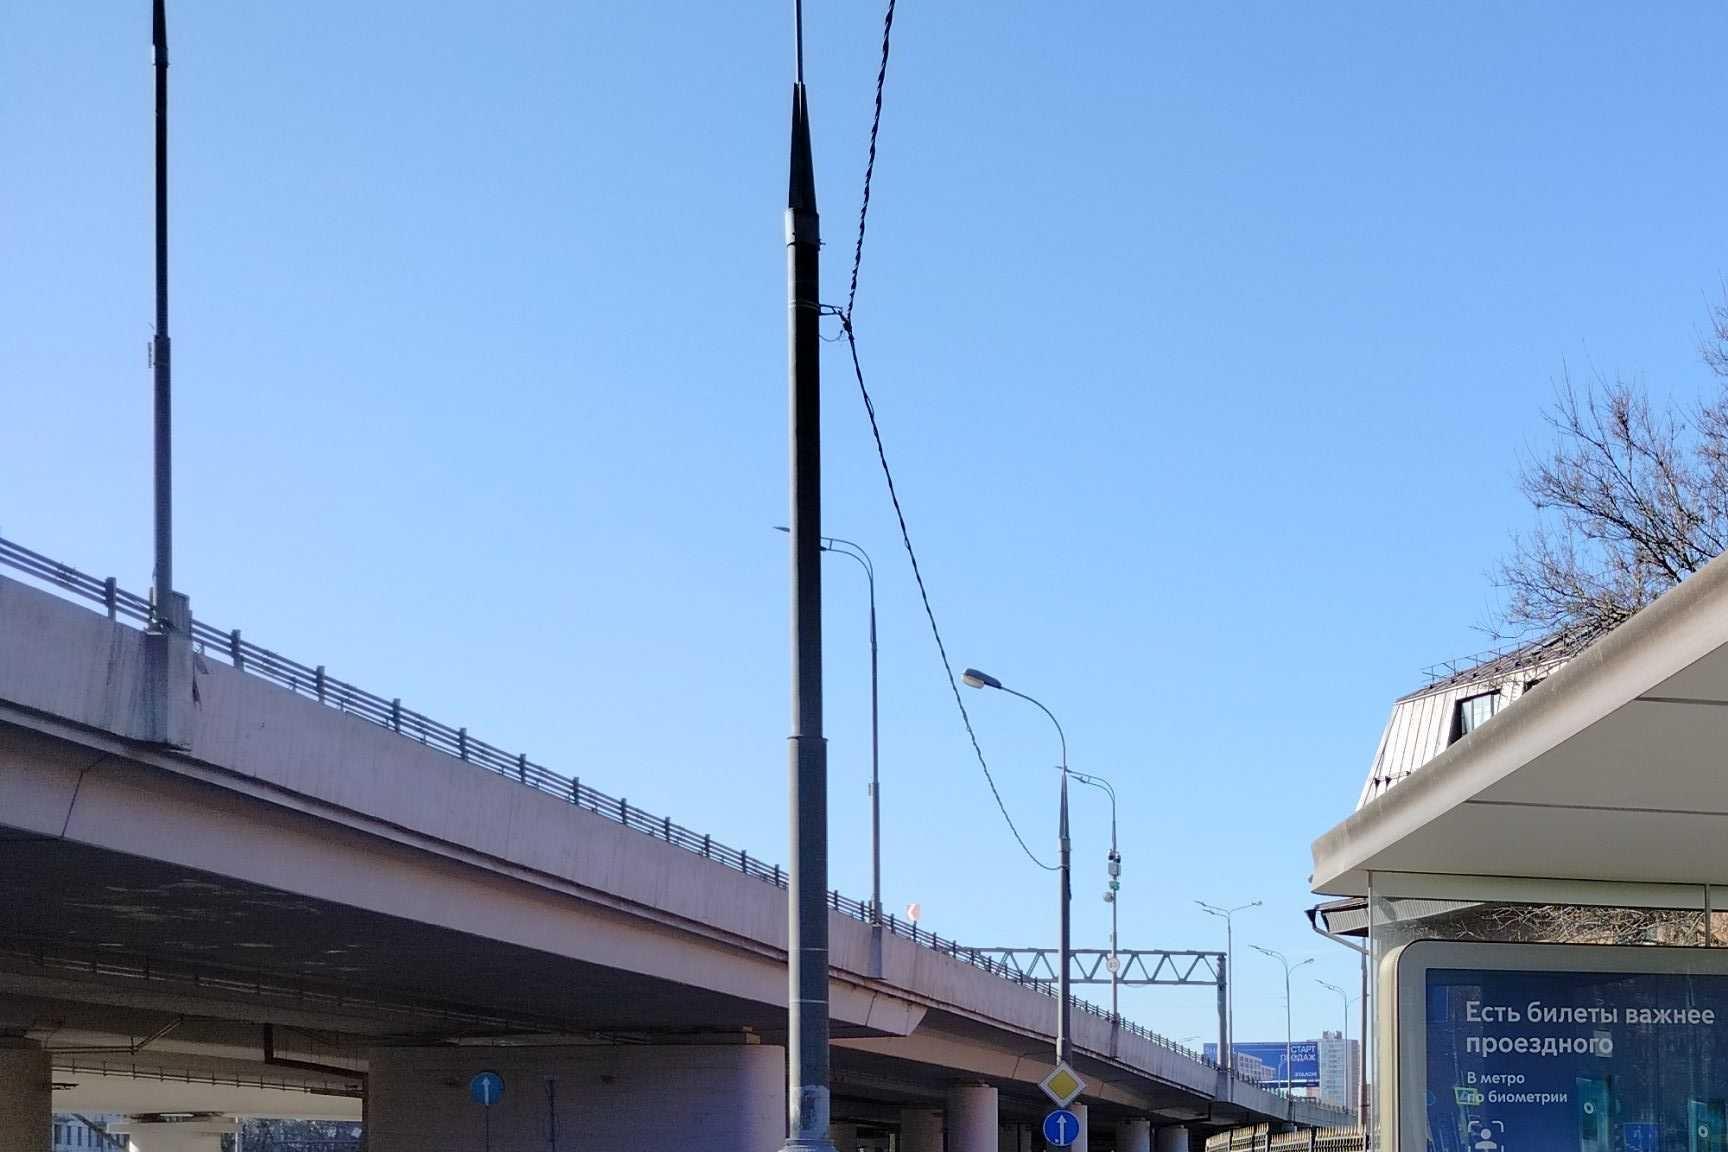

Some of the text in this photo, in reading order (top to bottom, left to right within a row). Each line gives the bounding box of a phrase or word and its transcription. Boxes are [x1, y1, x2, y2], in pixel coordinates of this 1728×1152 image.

[1466, 1000, 1716, 1026] Есть билеты важнее
[1290, 1045, 1316, 1053] СТАРТ
[1466, 1035, 1614, 1057] проездного
[1280, 1054, 1316, 1062] ПОДАЖ
[1467, 1072, 1525, 1087] В метро
[1467, 1091, 1568, 1105] по биометрии
